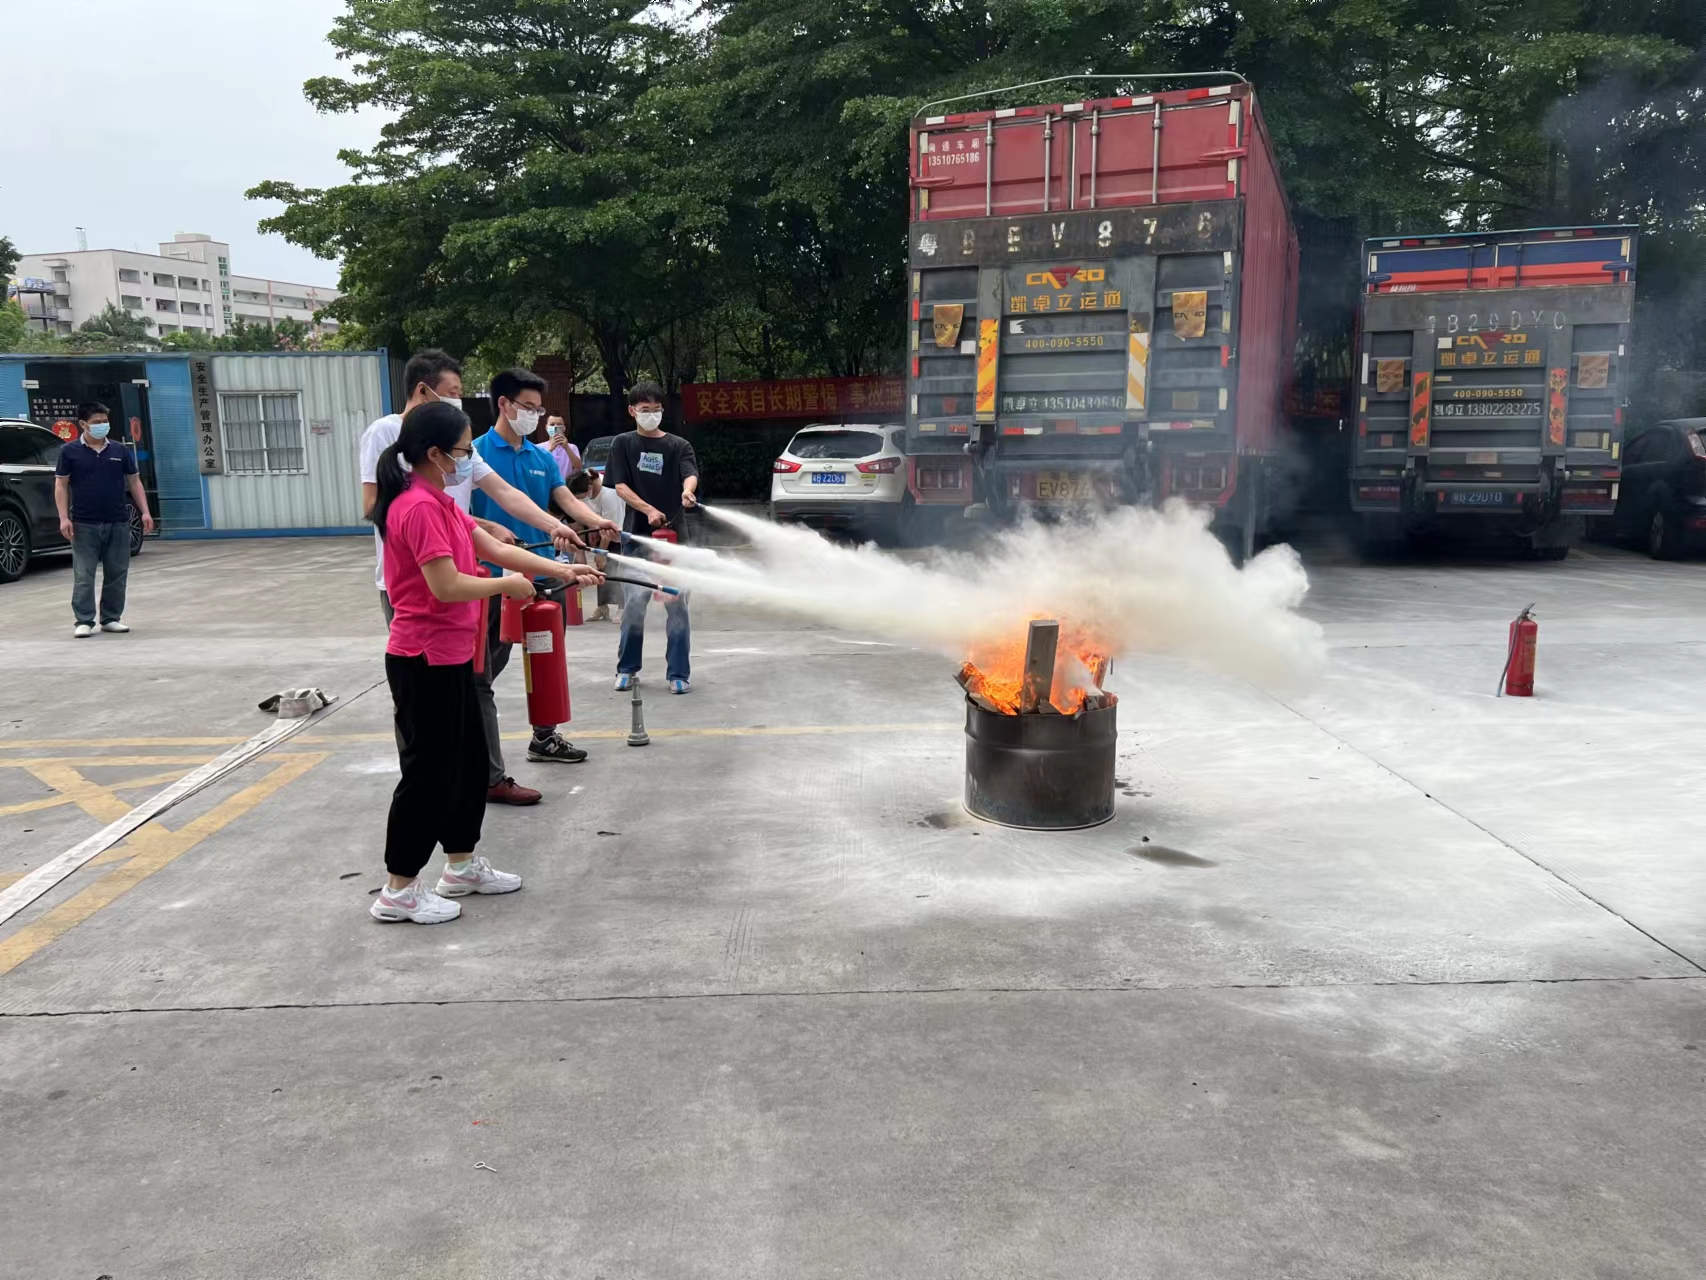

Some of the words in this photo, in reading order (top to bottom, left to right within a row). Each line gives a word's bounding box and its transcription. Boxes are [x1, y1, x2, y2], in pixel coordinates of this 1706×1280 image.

[928, 152, 980, 167] 13510765186
[1025, 336, 1104, 349] 400-090-5550
[696, 384, 838, 415] 安全来自长期警惕
[1453, 389, 1523, 398] 400-090-5550
[195, 361, 217, 469] 安全生产管理办公室
[1467, 402, 1541, 415] 13802283275
